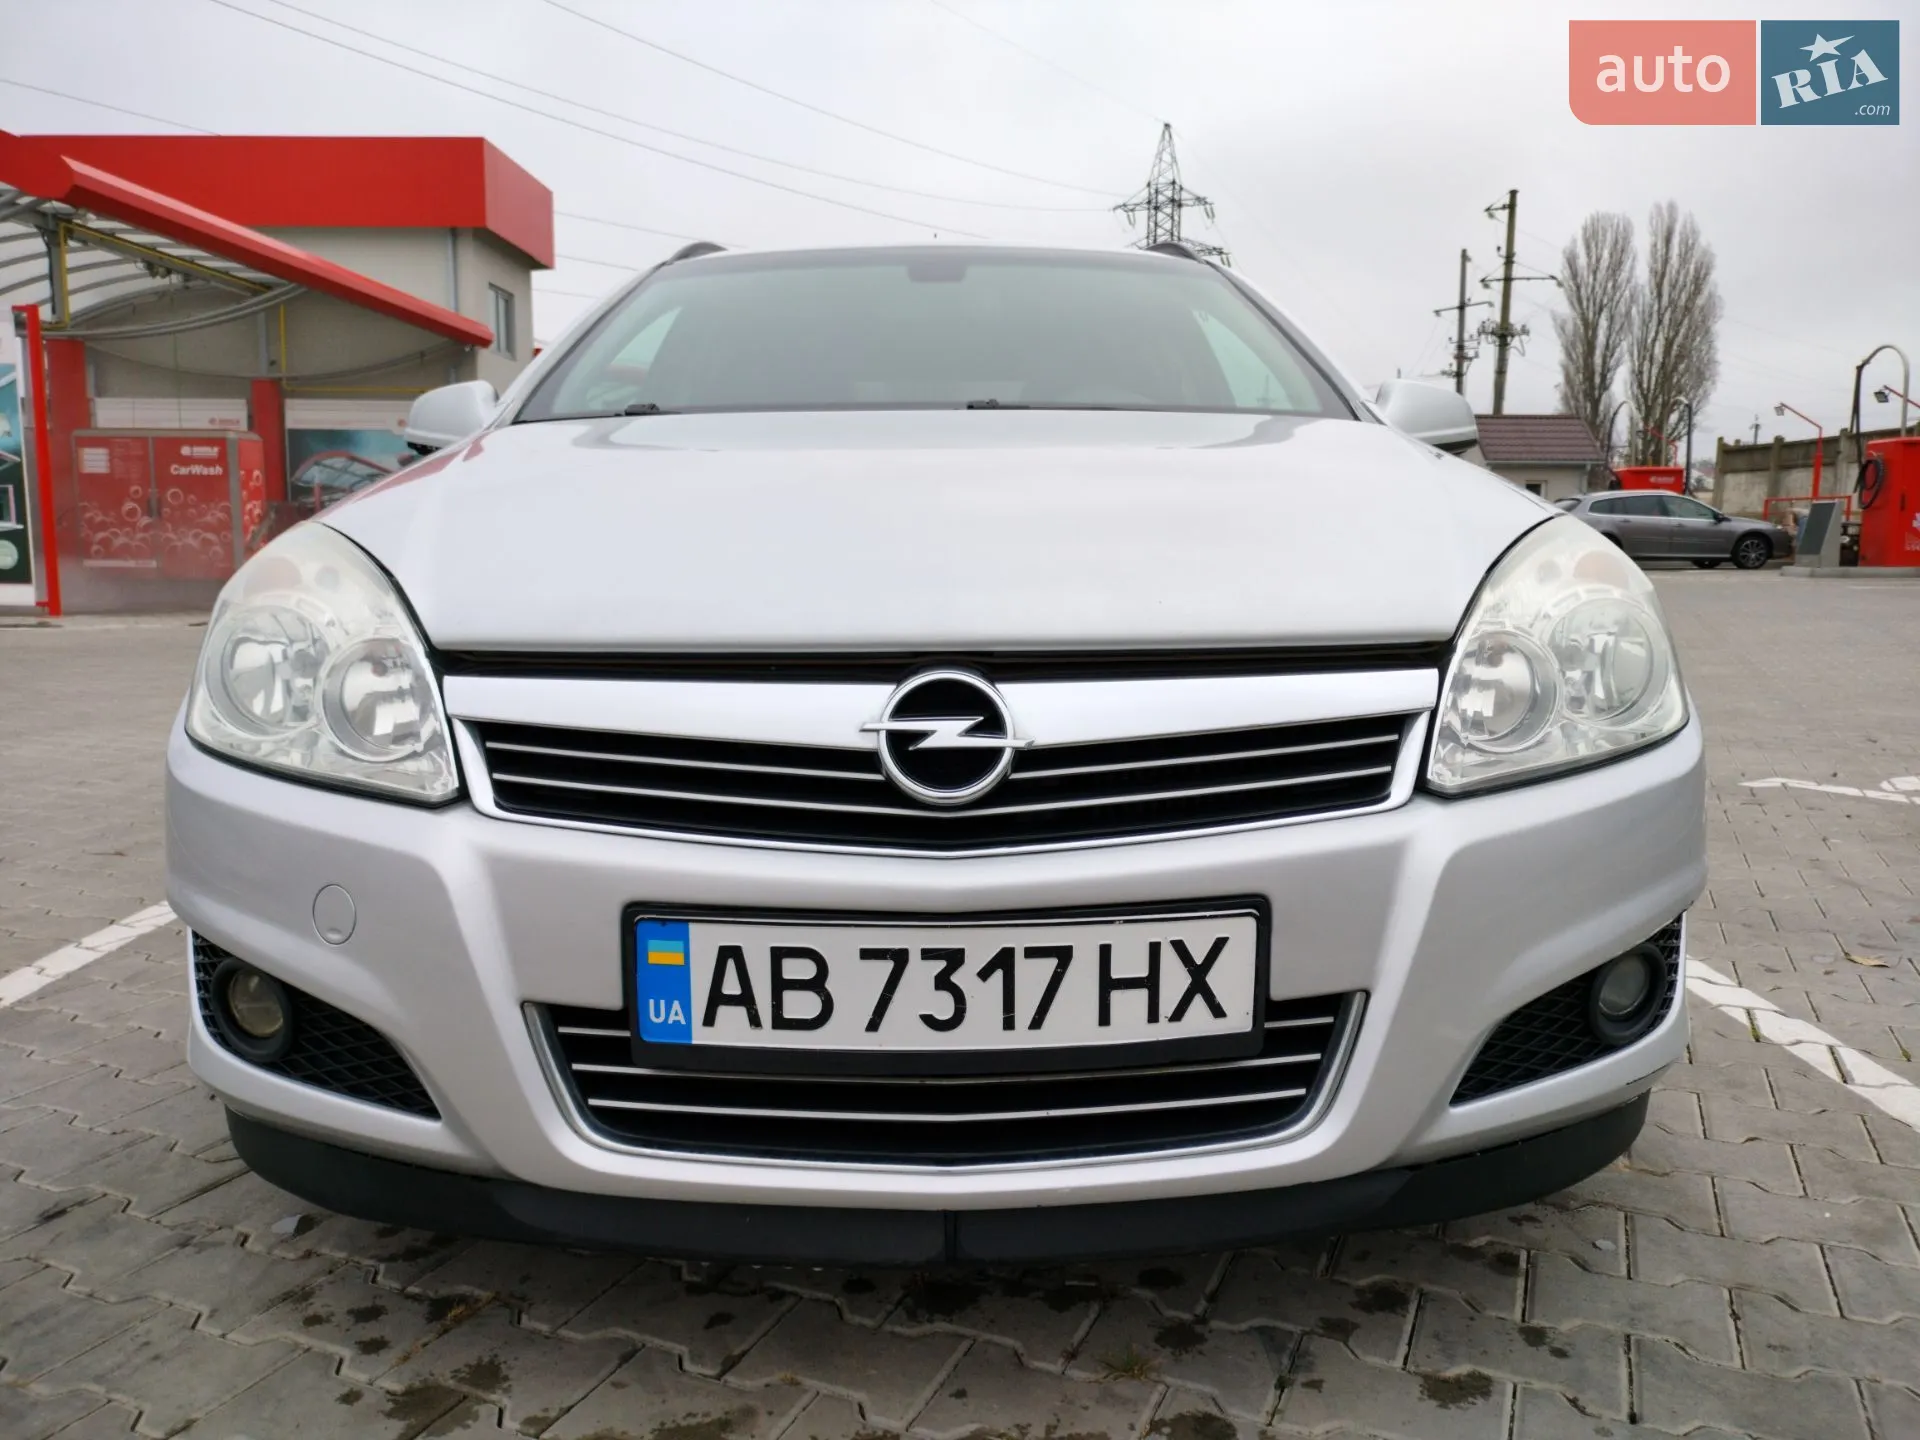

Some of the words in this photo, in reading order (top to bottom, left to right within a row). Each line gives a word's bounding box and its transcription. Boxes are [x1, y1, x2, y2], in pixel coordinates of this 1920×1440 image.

[170, 464, 223, 476] CarWash
[701, 945, 835, 1031] AB
[858, 944, 1074, 1033] 7317
[1097, 935, 1231, 1029] HX
[648, 998, 687, 1025] UA
